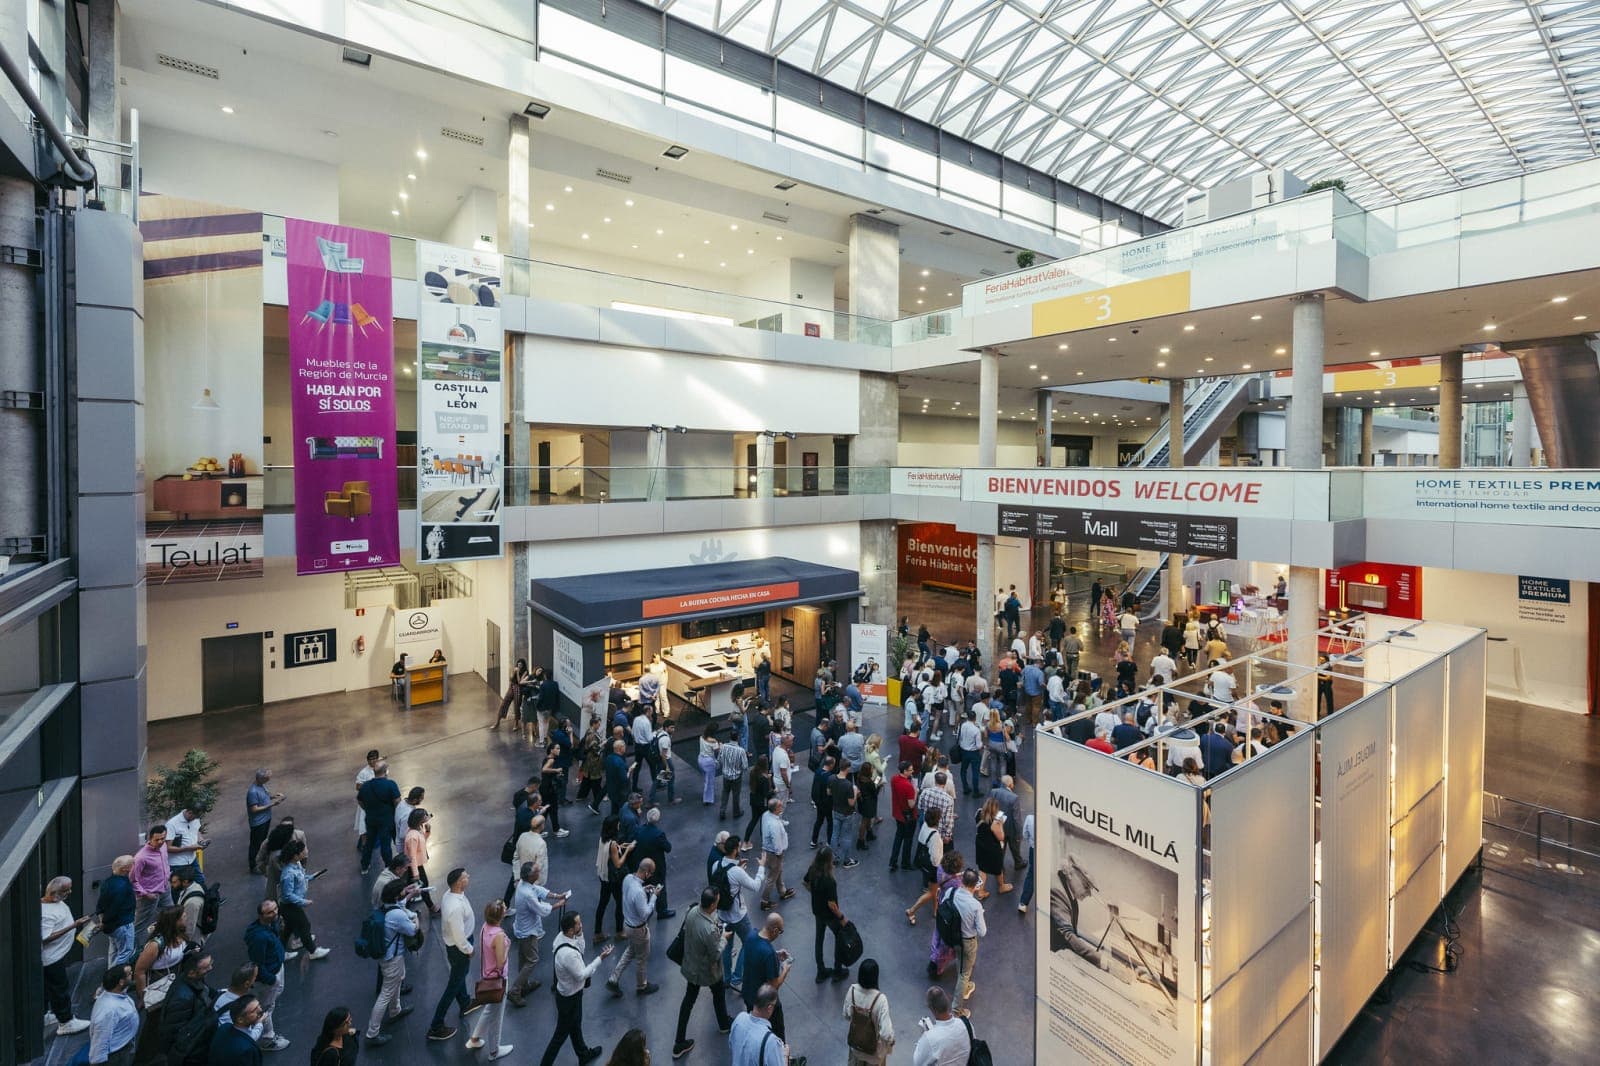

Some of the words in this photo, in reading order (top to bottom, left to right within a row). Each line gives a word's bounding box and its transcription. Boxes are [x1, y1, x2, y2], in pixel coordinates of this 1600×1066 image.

[1096, 294, 1112, 321] 3
[306, 358, 351, 368] Muebles
[353, 361, 366, 369] de
[368, 361, 378, 370] la
[299, 368, 336, 379] Región
[339, 371, 352, 379] de
[354, 372, 388, 380] Murcia
[1384, 372, 1396, 387] 3
[306, 384, 355, 396] HABLAN
[358, 386, 381, 397] POR
[434, 383, 488, 393] CASTILLA
[319, 397, 331, 410] SÍ
[333, 399, 371, 411] SOLOS
[447, 400, 477, 408] LEÓN
[988, 477, 1121, 498] BIENVENIDOS
[1135, 480, 1263, 503] WELCOME
[1416, 480, 1461, 489] HOME
[1468, 480, 1543, 490] TEXTILES
[1416, 500, 1478, 508] International
[1480, 501, 1510, 509] home
[1512, 503, 1546, 511] textile
[1548, 503, 1569, 511] and
[1085, 520, 1118, 537] Mall
[151, 541, 252, 568] Teulat
[905, 555, 927, 566] Feria
[680, 600, 688, 608] LA
[689, 598, 708, 607] BUENA
[708, 596, 730, 604] COCINA
[730, 593, 749, 601] HECHA
[757, 590, 771, 598] CASA
[1521, 590, 1566, 599] PREMIUM
[1050, 791, 1121, 837] MIGUEL
[1126, 824, 1179, 864] MILÁ
